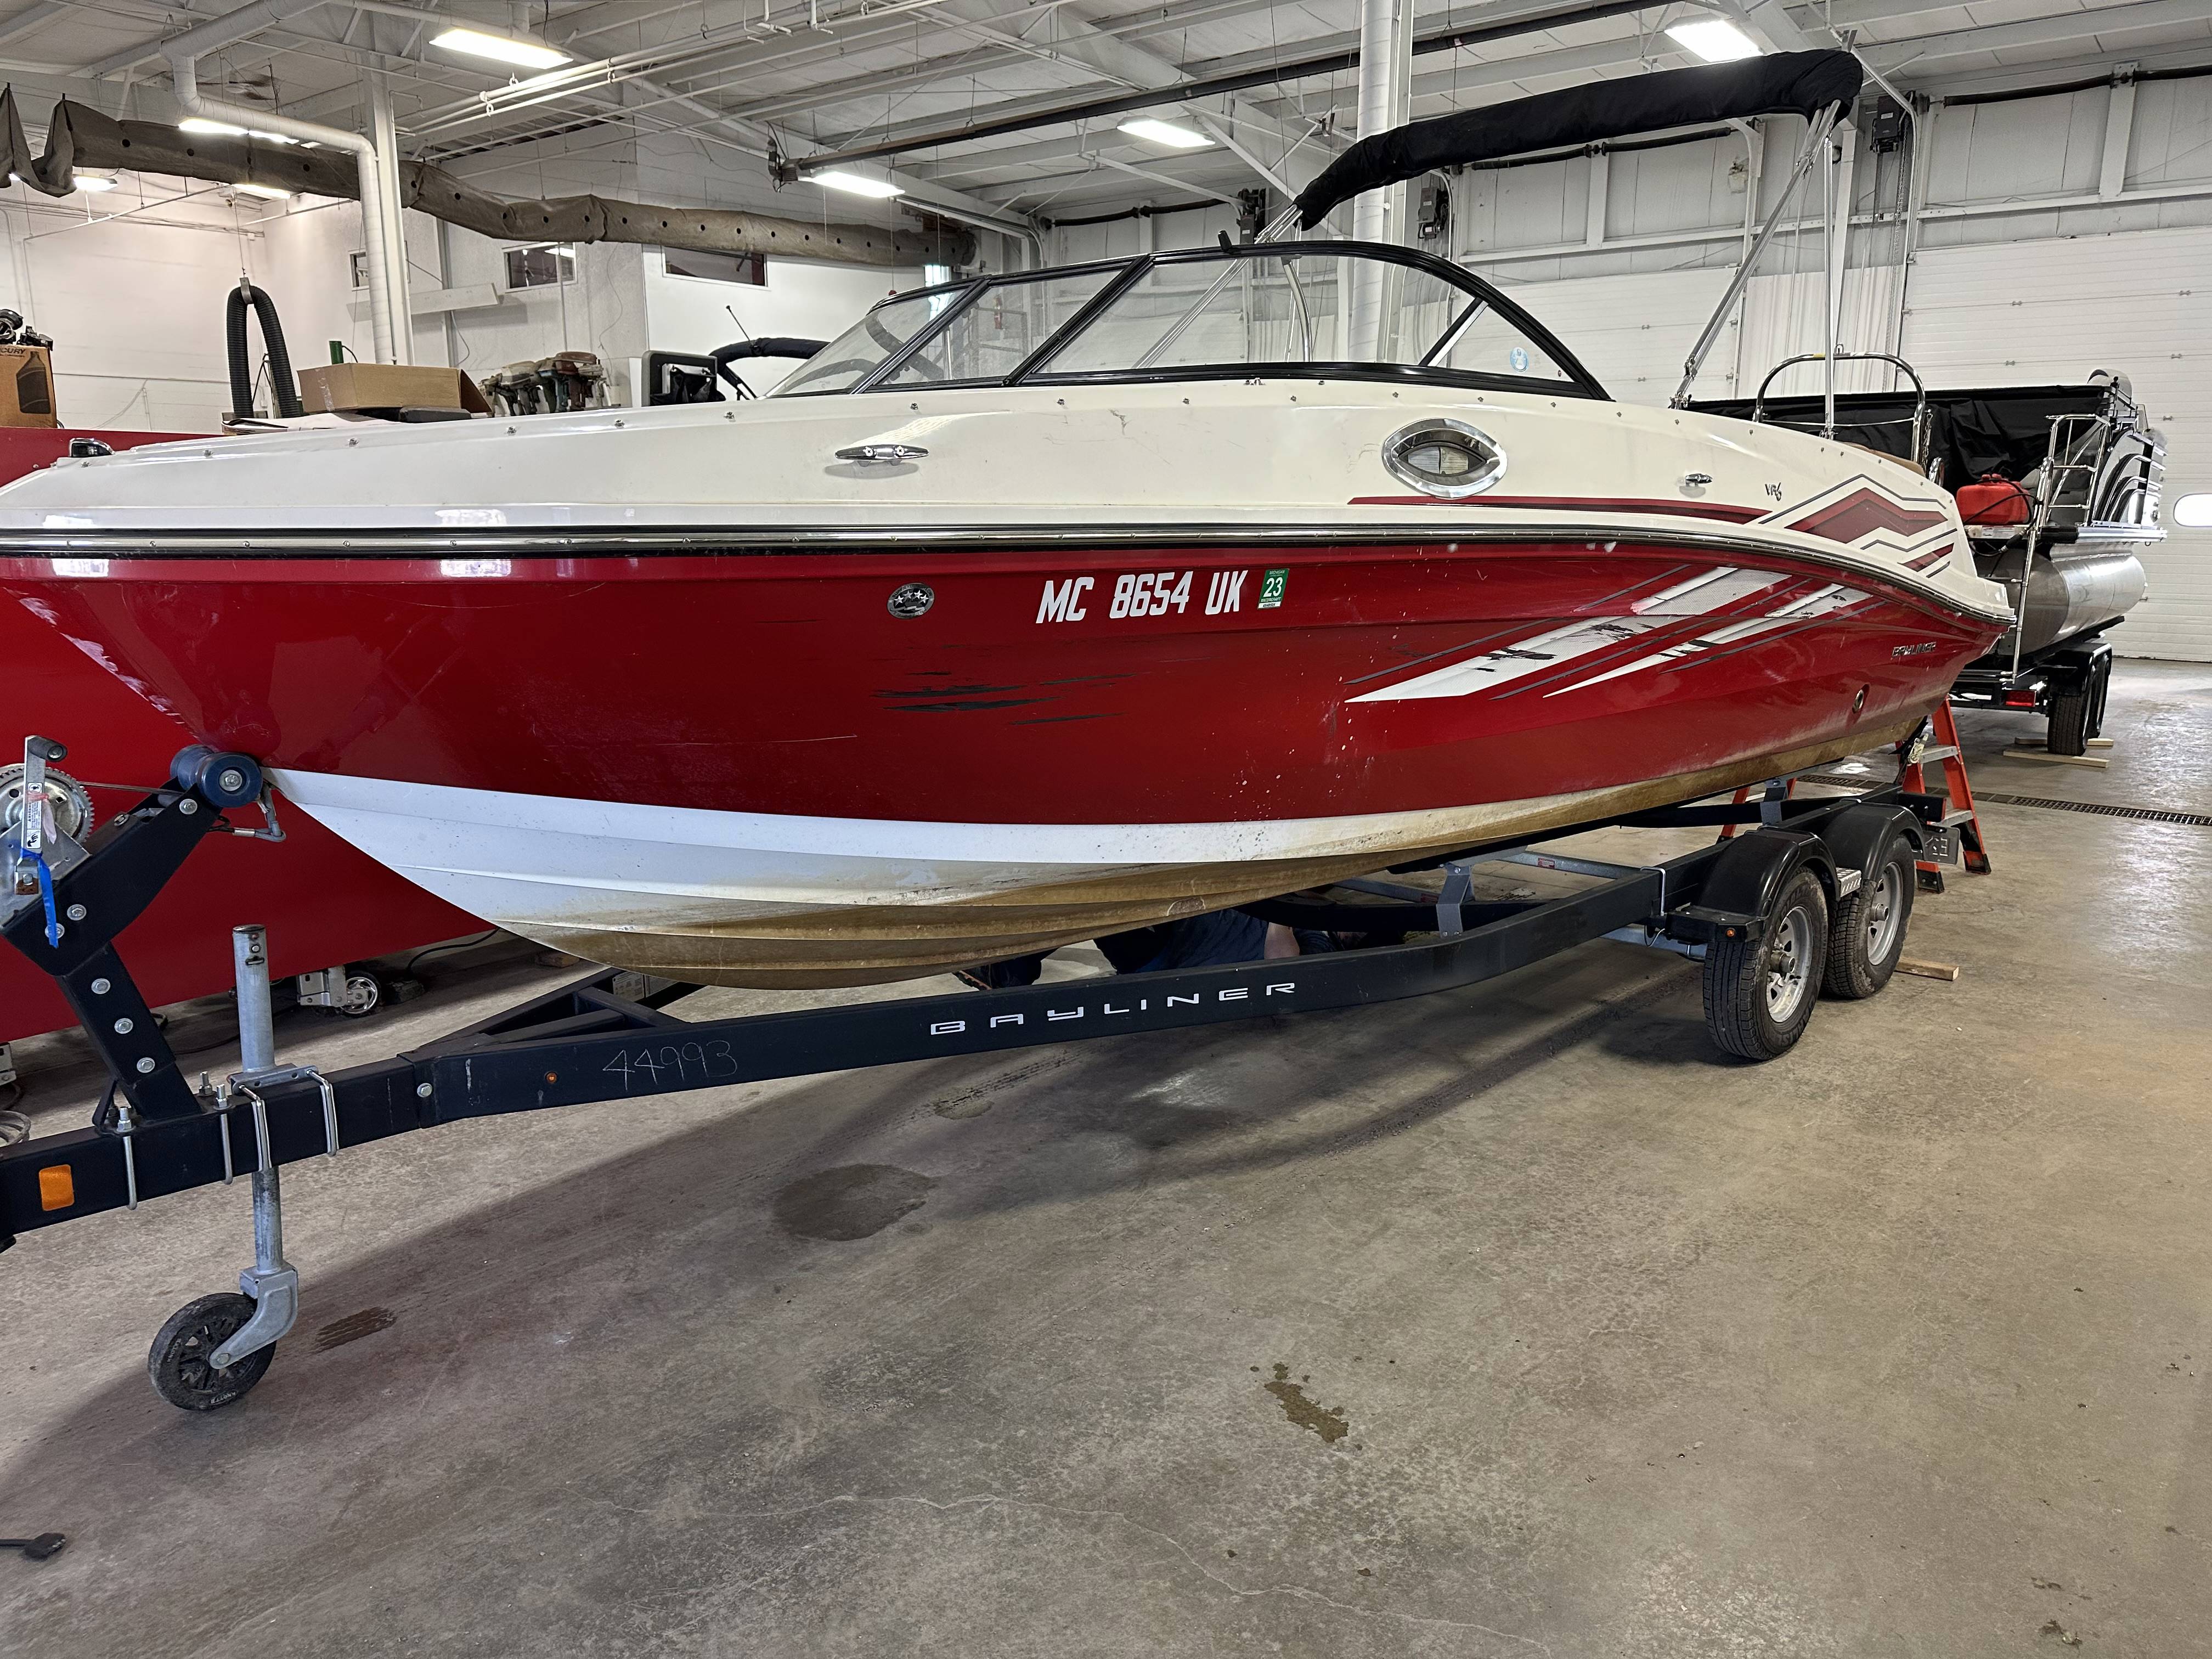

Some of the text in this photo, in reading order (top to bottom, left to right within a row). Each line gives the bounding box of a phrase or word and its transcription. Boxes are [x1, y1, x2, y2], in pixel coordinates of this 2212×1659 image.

[1765, 482, 1782, 501] VR6
[1036, 569, 1248, 624] MC 8654 UK
[1263, 577, 1283, 597] 23
[1892, 641, 1937, 657] BAYLINER
[930, 983, 1295, 1035] BAYLINER
[603, 1040, 737, 1091] 44993
